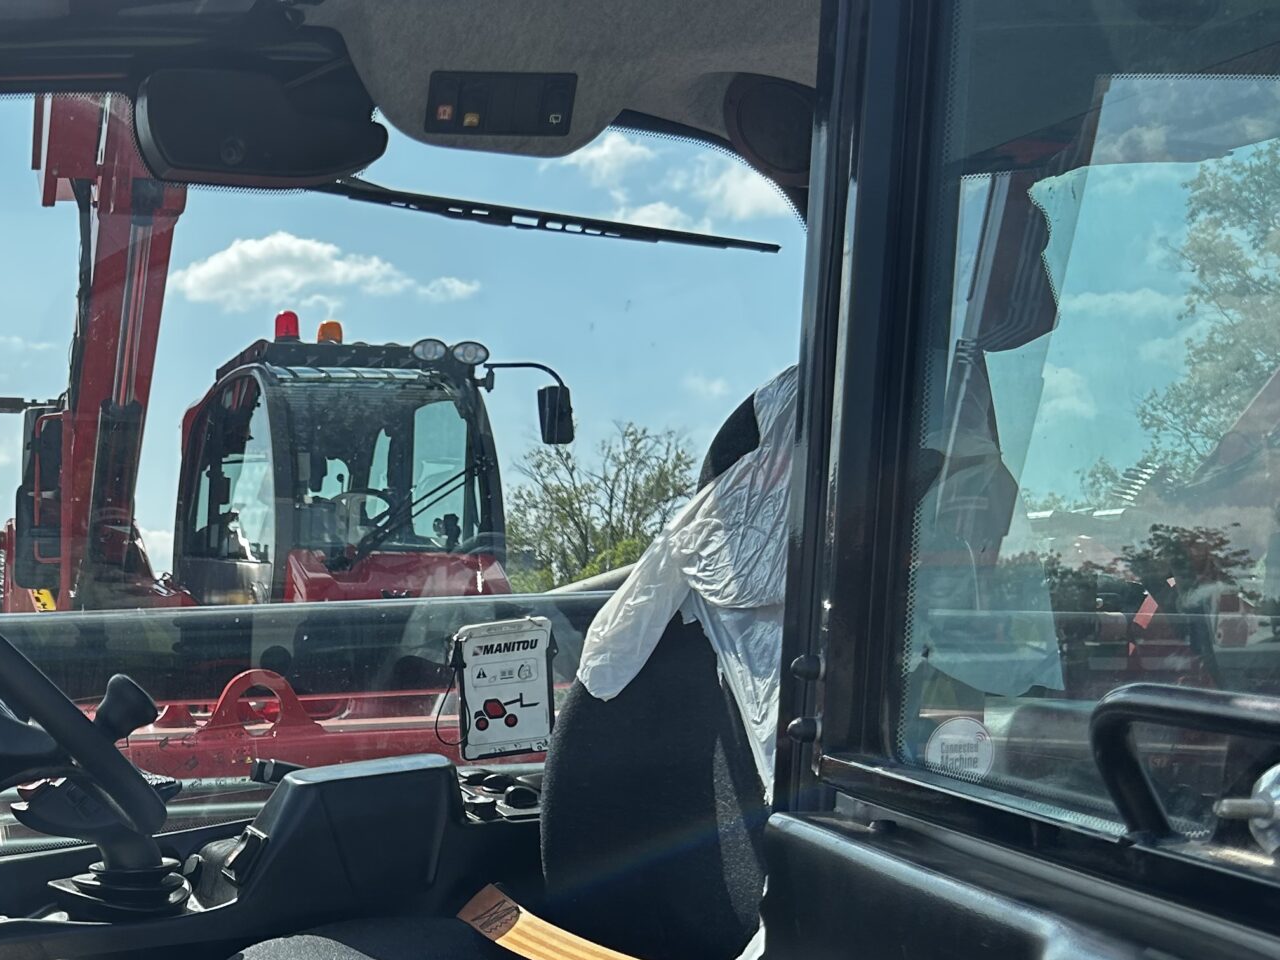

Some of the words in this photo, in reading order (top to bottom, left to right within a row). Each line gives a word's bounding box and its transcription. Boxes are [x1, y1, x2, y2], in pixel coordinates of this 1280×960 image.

[483, 639, 539, 655] MANITOU
[940, 740, 979, 753] Connected
[940, 753, 979, 769] Machine
